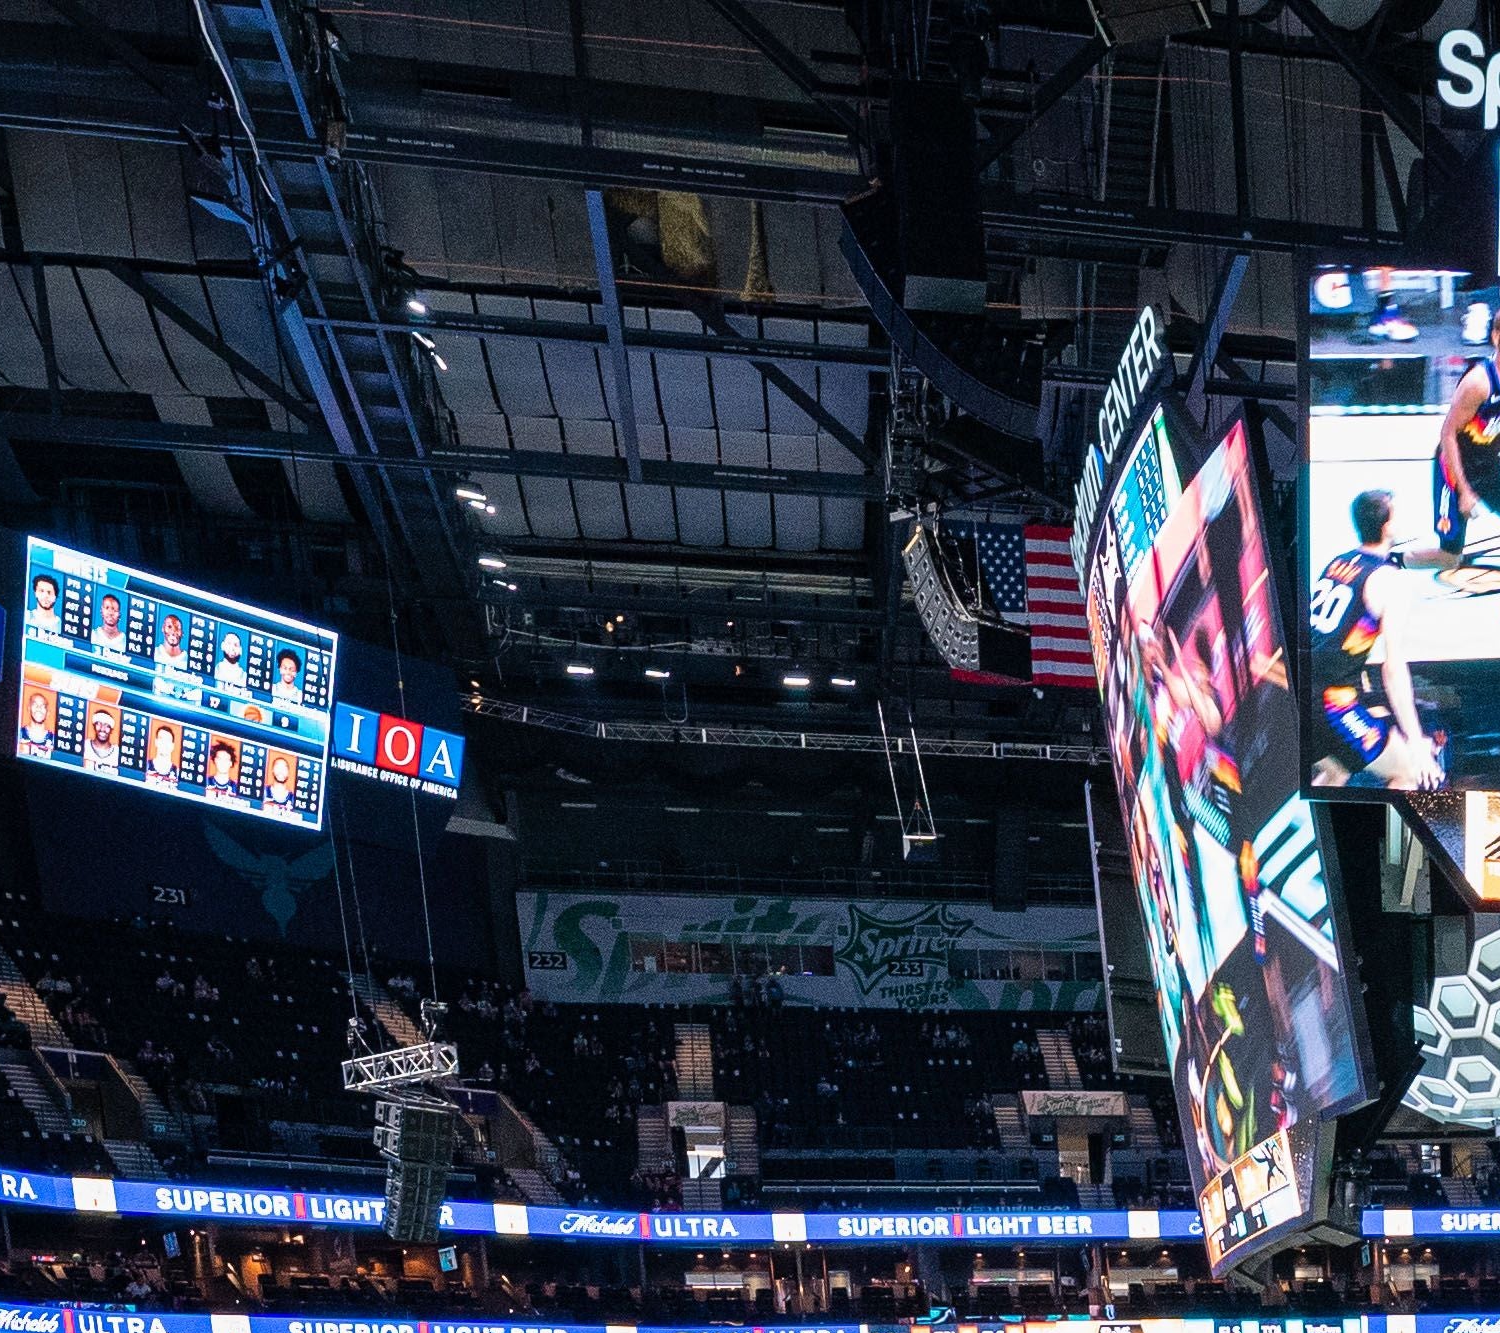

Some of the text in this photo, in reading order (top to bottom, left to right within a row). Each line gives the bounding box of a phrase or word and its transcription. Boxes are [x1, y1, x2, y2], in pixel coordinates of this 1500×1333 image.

[1099, 306, 1161, 464] CENTER
[380, 770, 457, 800] OFFICE OF AMERICA
[153, 885, 186, 905] 231
[532, 951, 564, 969] 232
[890, 962, 922, 976] 233
[156, 1188, 384, 1222] SUPERIOR LIGHT
[561, 1213, 738, 1239] Michelob ULTRA
[838, 1214, 1093, 1237] SUPERIOR LIGHT BEER
